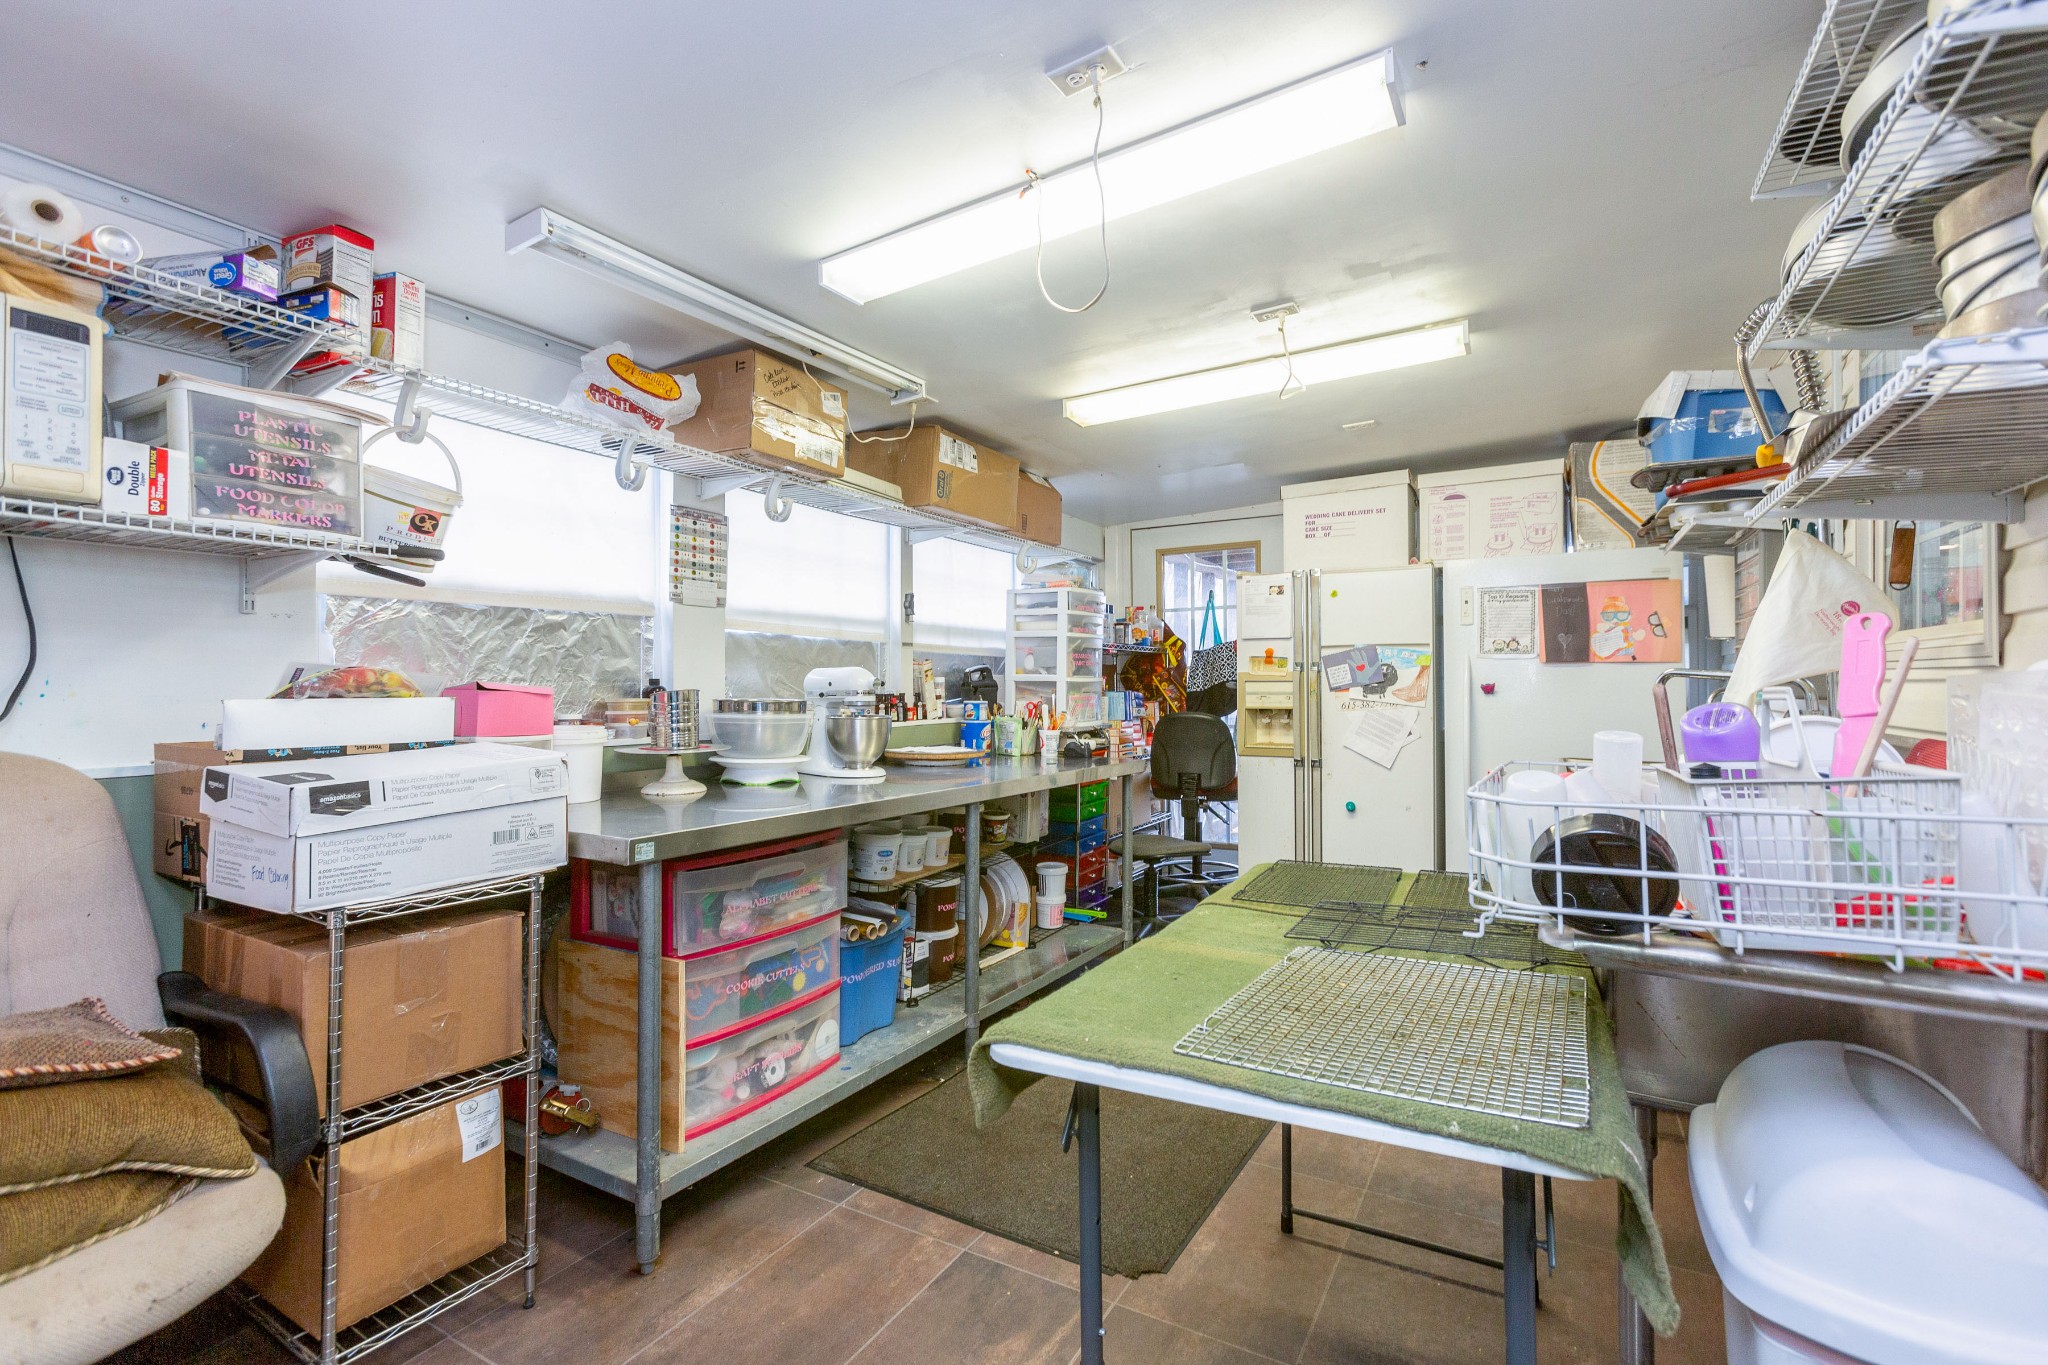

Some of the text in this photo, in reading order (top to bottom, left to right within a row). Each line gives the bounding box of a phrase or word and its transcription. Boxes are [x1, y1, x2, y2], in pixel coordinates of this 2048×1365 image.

[296, 236, 315, 249] GFS
[638, 370, 673, 397] Premium
[238, 411, 323, 437] PLASTIC
[234, 424, 331, 455] UTENSILS
[248, 449, 318, 469] METAL
[128, 461, 140, 496] Double
[155, 473, 165, 499] Storage
[229, 463, 328, 489] UTENSILS
[150, 500, 160, 512] 80
[215, 485, 346, 515] FOOD COLOR
[237, 503, 332, 528] MARKERS
[414, 513, 438, 532] CK
[391, 771, 461, 786] Multipurpose Copy Paper
[392, 785, 411, 794] Papier
[412, 780, 455, 791] Reprographique
[461, 778, 478, 786] Usage
[479, 775, 498, 783] Multiple
[320, 792, 361, 804] amazonbasics
[392, 793, 409, 801] Papel
[410, 791, 419, 799] De
[419, 789, 437, 798] Copia
[318, 831, 407, 849] Multipurpose Copy Paper
[318, 848, 342, 858] Papier
[343, 840, 399, 854] Reprographique
[406, 836, 428, 846] Usage
[428, 832, 453, 842] Multiple
[318, 857, 339, 867] Papel
[340, 855, 352, 863] De
[352, 852, 375, 862] Copia
[252, 865, 265, 881] Food
[268, 867, 289, 890] Coloring
[725, 893, 778, 915] ALPHABET
[726, 973, 765, 995] COOKIE
[730, 1062, 760, 1082] RAFT
